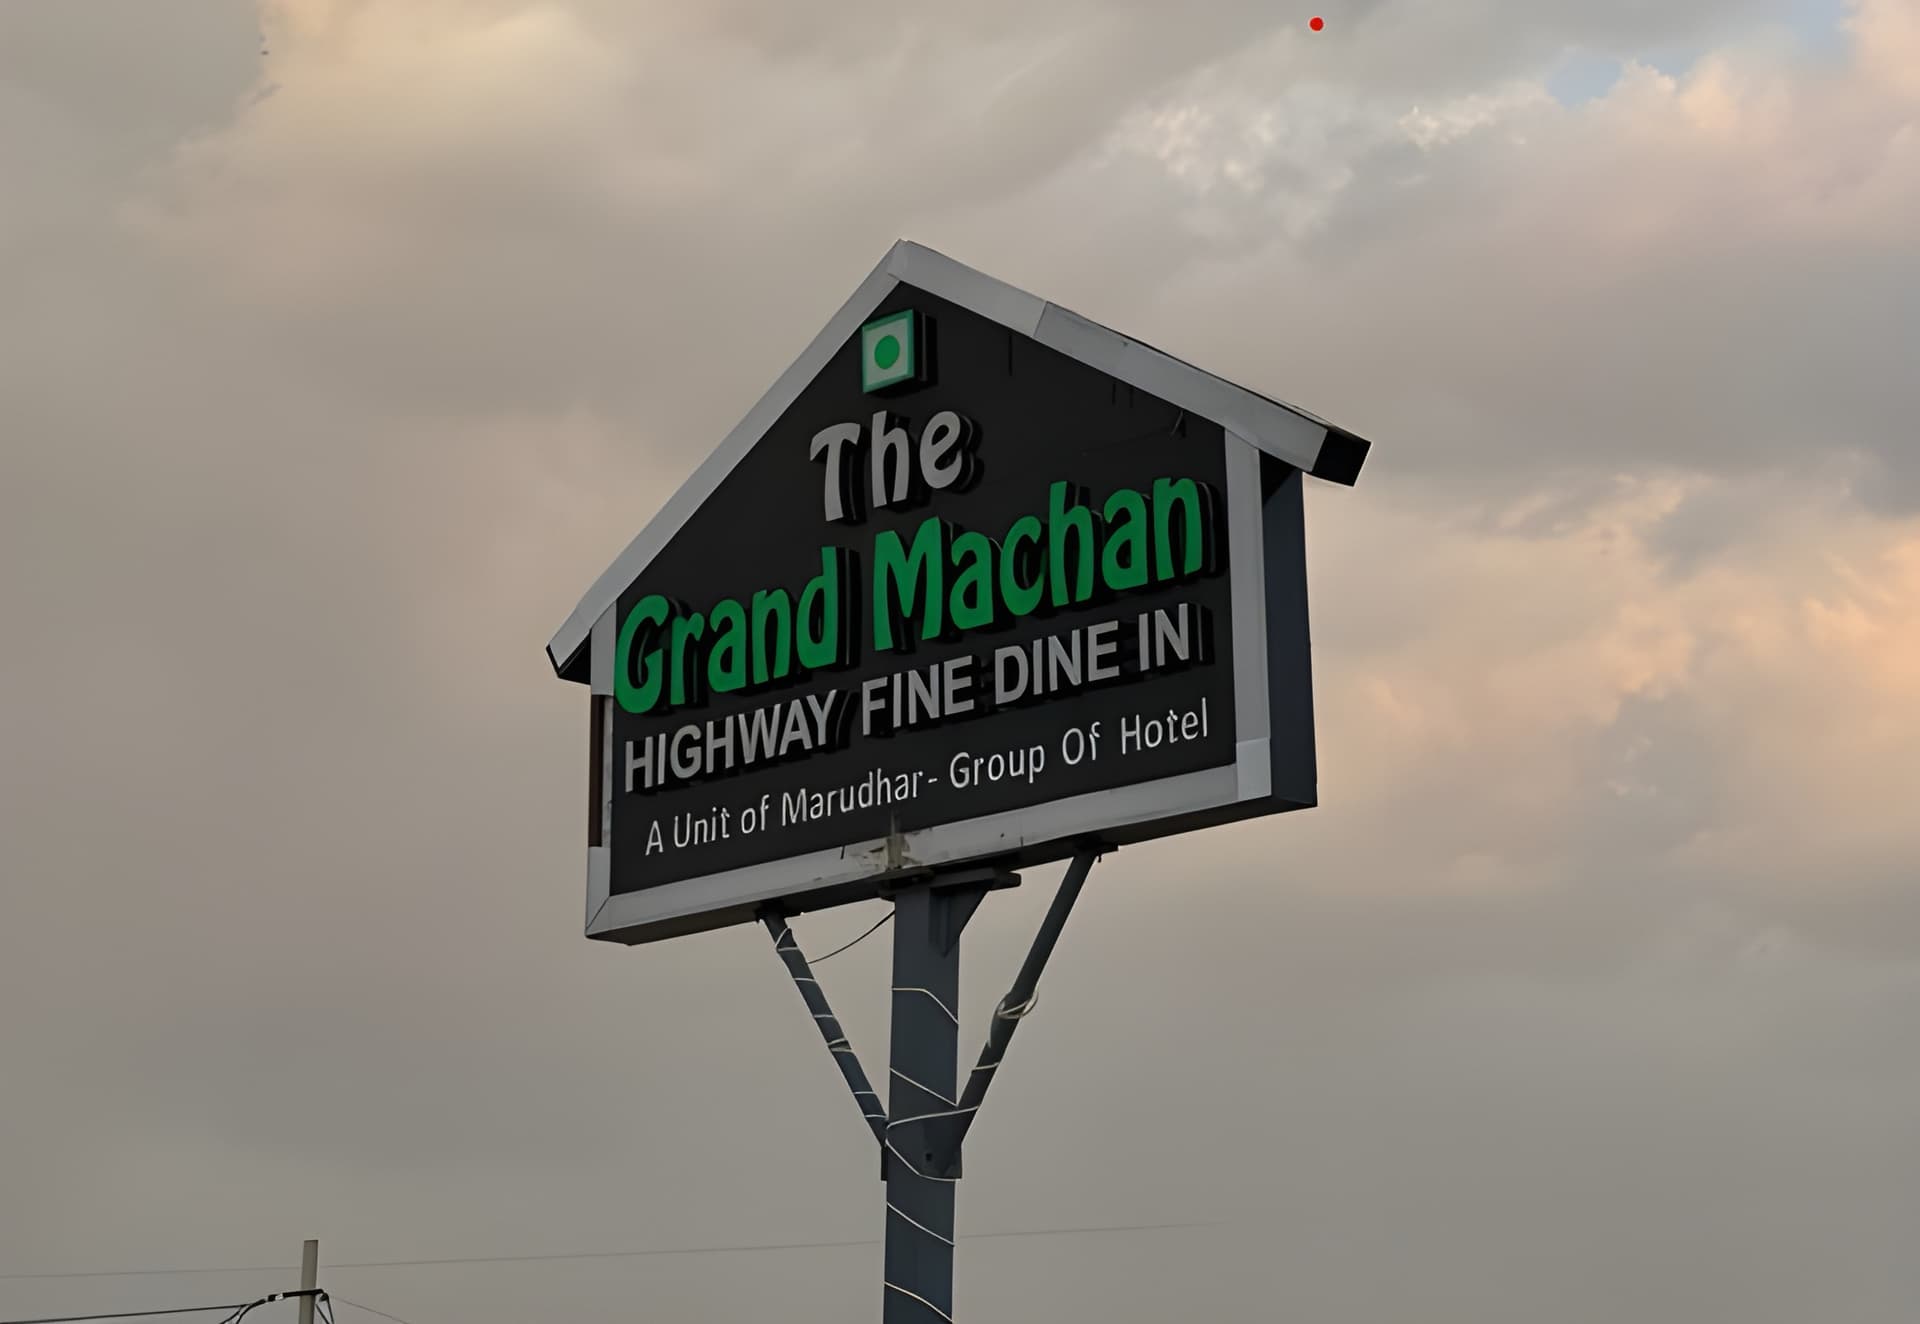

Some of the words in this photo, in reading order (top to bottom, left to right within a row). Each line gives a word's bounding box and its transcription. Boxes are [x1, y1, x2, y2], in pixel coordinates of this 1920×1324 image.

[809, 409, 964, 522] The
[614, 545, 838, 714] Grand
[873, 476, 1203, 652] Machan
[624, 688, 838, 793] HIGHWAY
[862, 655, 975, 736] FINE
[993, 621, 1120, 703] DINE
[1137, 602, 1190, 672] IN
[645, 820, 664, 856] A
[673, 806, 730, 847] Unit
[740, 794, 770, 833] of
[949, 745, 1046, 790] Group
[1062, 721, 1100, 765] Of
[1120, 695, 1208, 754] Hotel
